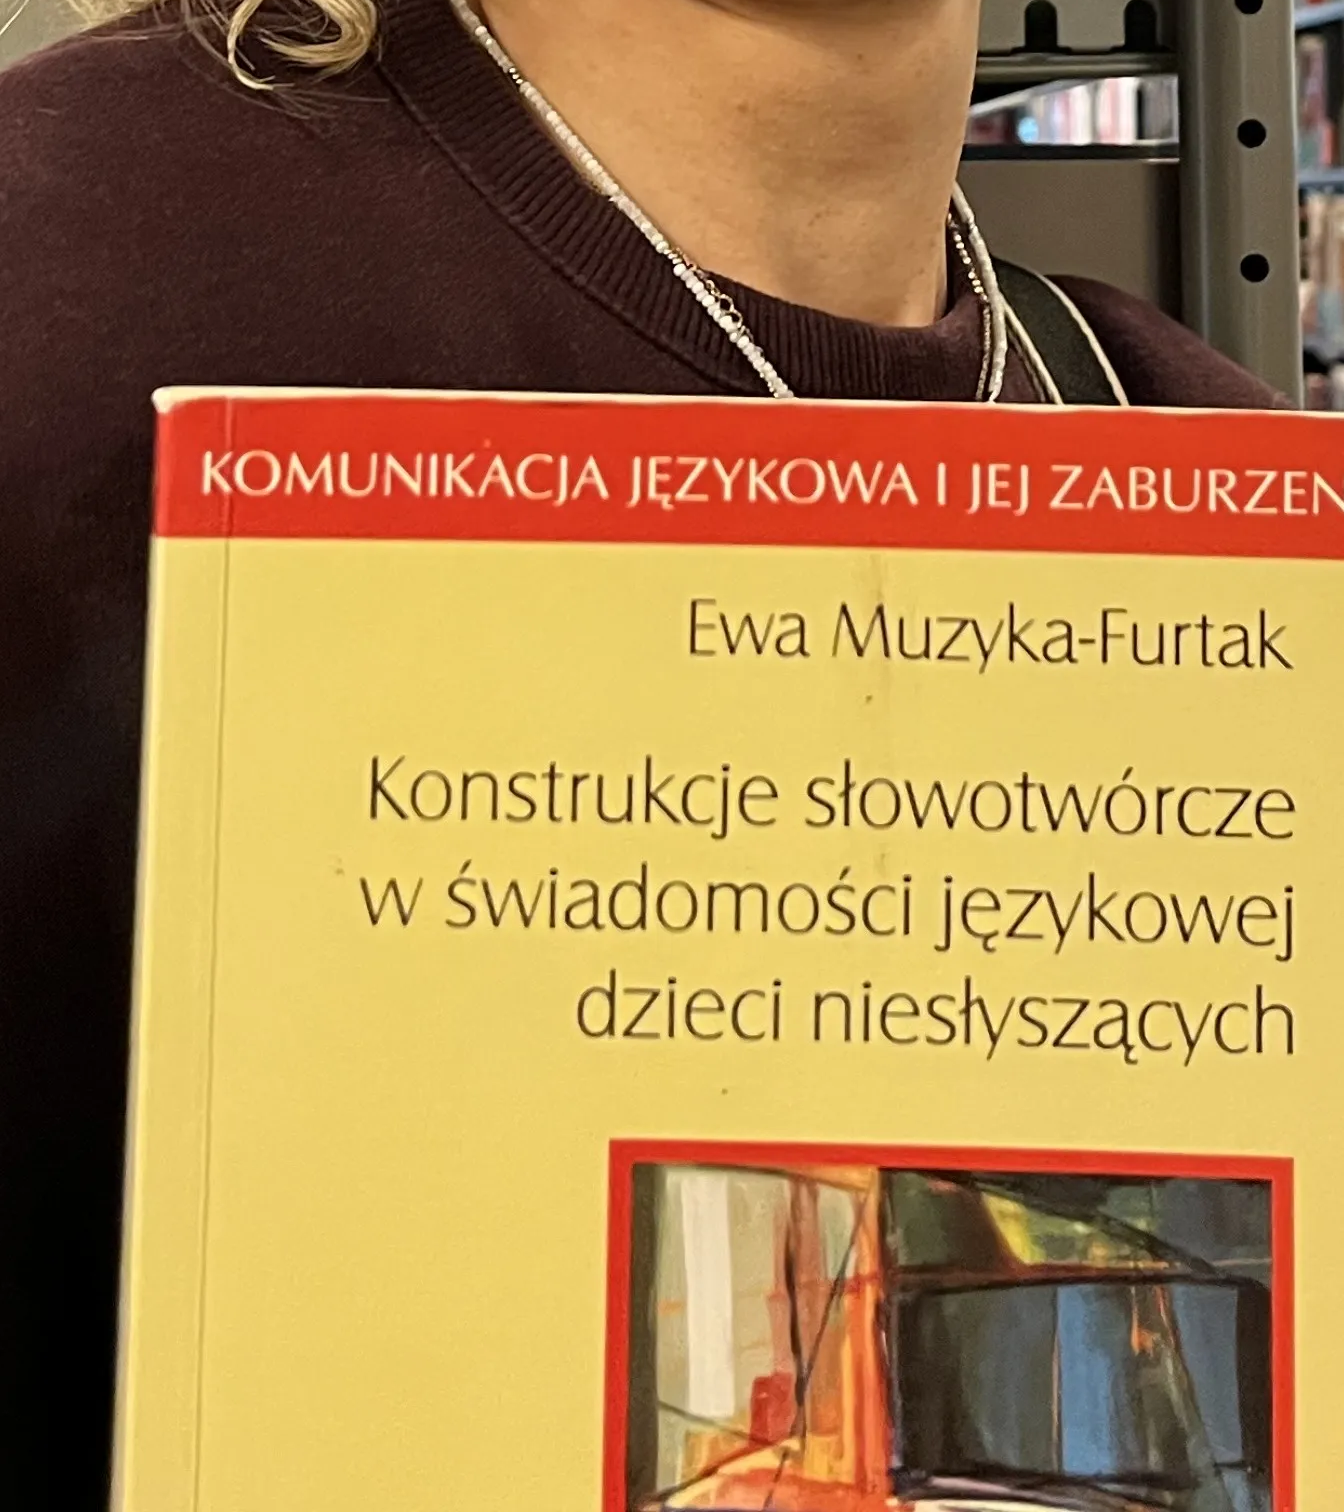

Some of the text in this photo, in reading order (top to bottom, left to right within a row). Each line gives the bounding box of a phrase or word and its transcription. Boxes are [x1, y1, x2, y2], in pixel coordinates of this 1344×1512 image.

[201, 449, 610, 507] KOMUNIKACJA
[625, 455, 919, 511] JĘZYKOWA
[937, 462, 948, 506] I
[967, 463, 1030, 516] JEJ
[689, 598, 1294, 675] Ewa Muzyka-Furtak
[369, 754, 1297, 841] Konstrukcje słowotwórcze
[359, 858, 1295, 964] w świadomości językowej
[576, 968, 1295, 1068] dzieci niesłyszących
